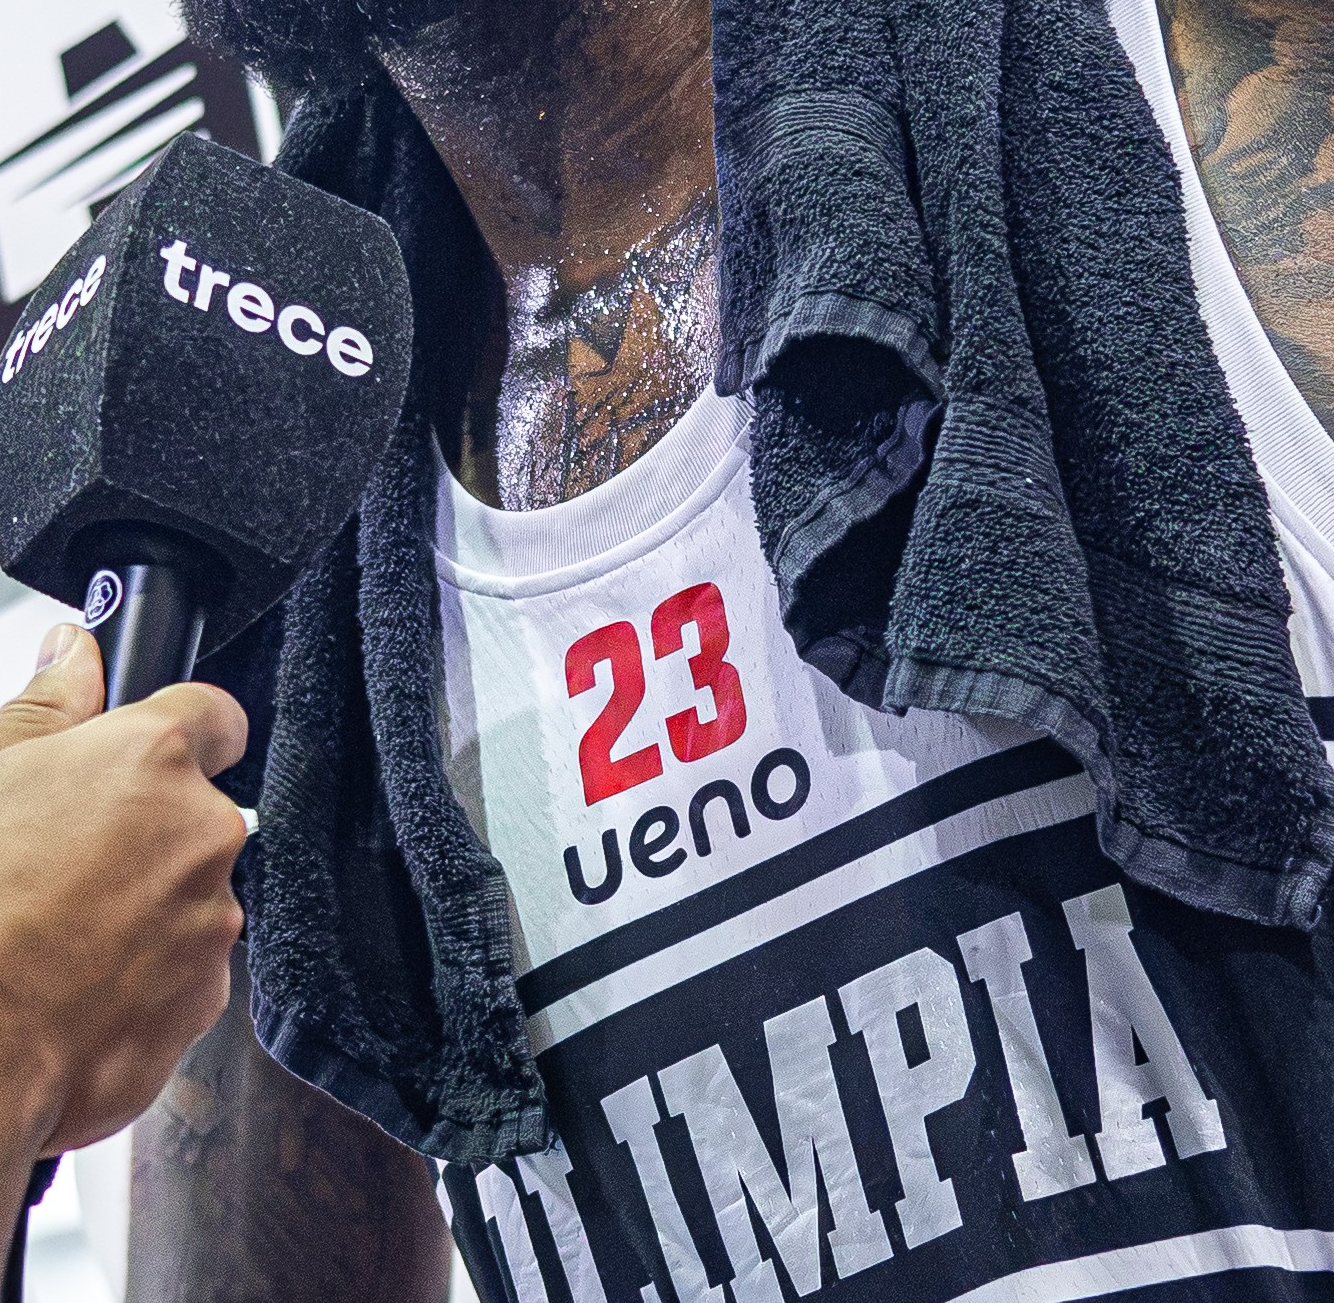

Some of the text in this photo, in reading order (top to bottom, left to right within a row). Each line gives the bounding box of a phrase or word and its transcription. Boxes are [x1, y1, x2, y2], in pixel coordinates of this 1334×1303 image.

[1, 254, 107, 384] trece
[159, 239, 375, 378] trece
[564, 581, 747, 807] 23
[563, 747, 811, 906] ueno
